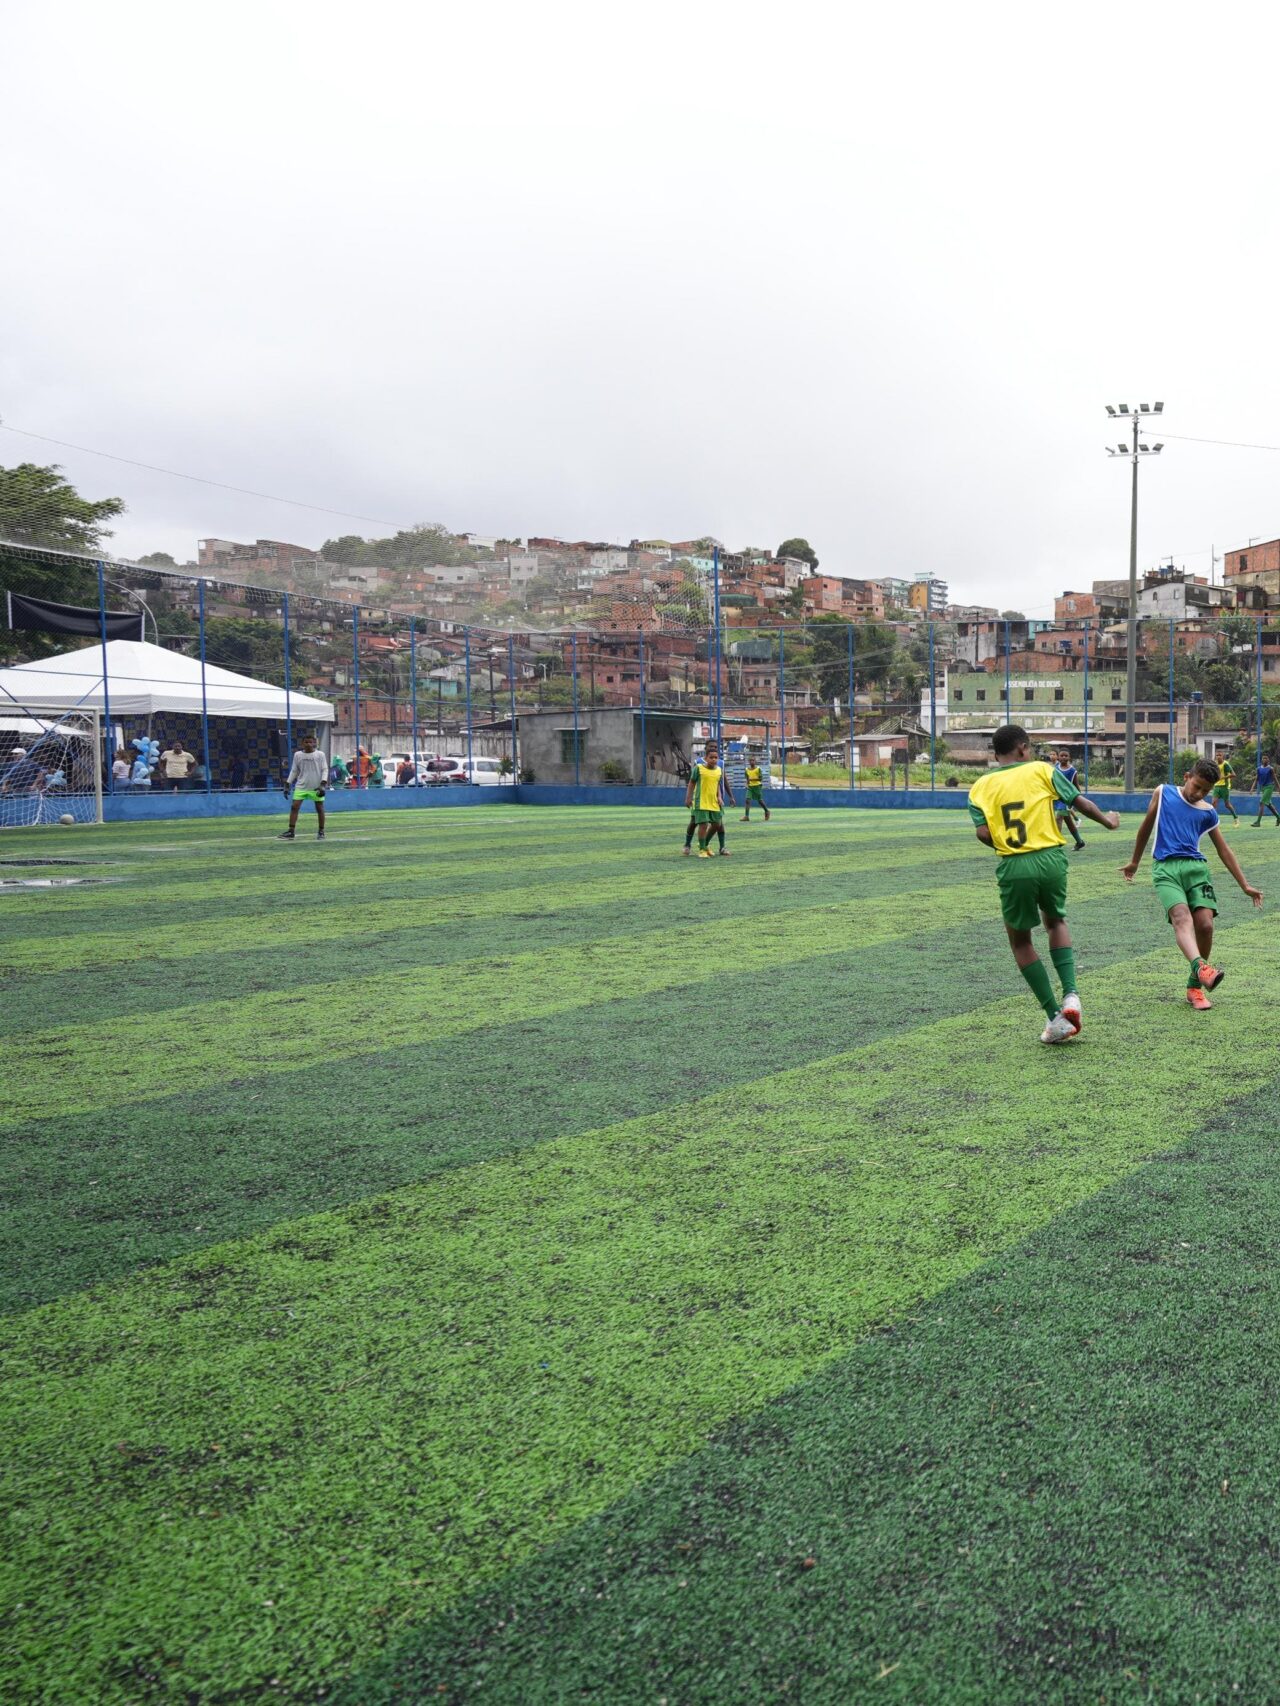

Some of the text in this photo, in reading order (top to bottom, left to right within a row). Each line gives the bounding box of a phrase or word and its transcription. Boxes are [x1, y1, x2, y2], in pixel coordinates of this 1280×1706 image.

[1038, 680, 1046, 688] DE
[1046, 680, 1061, 688] DEUS
[1000, 800, 1028, 849] 5
